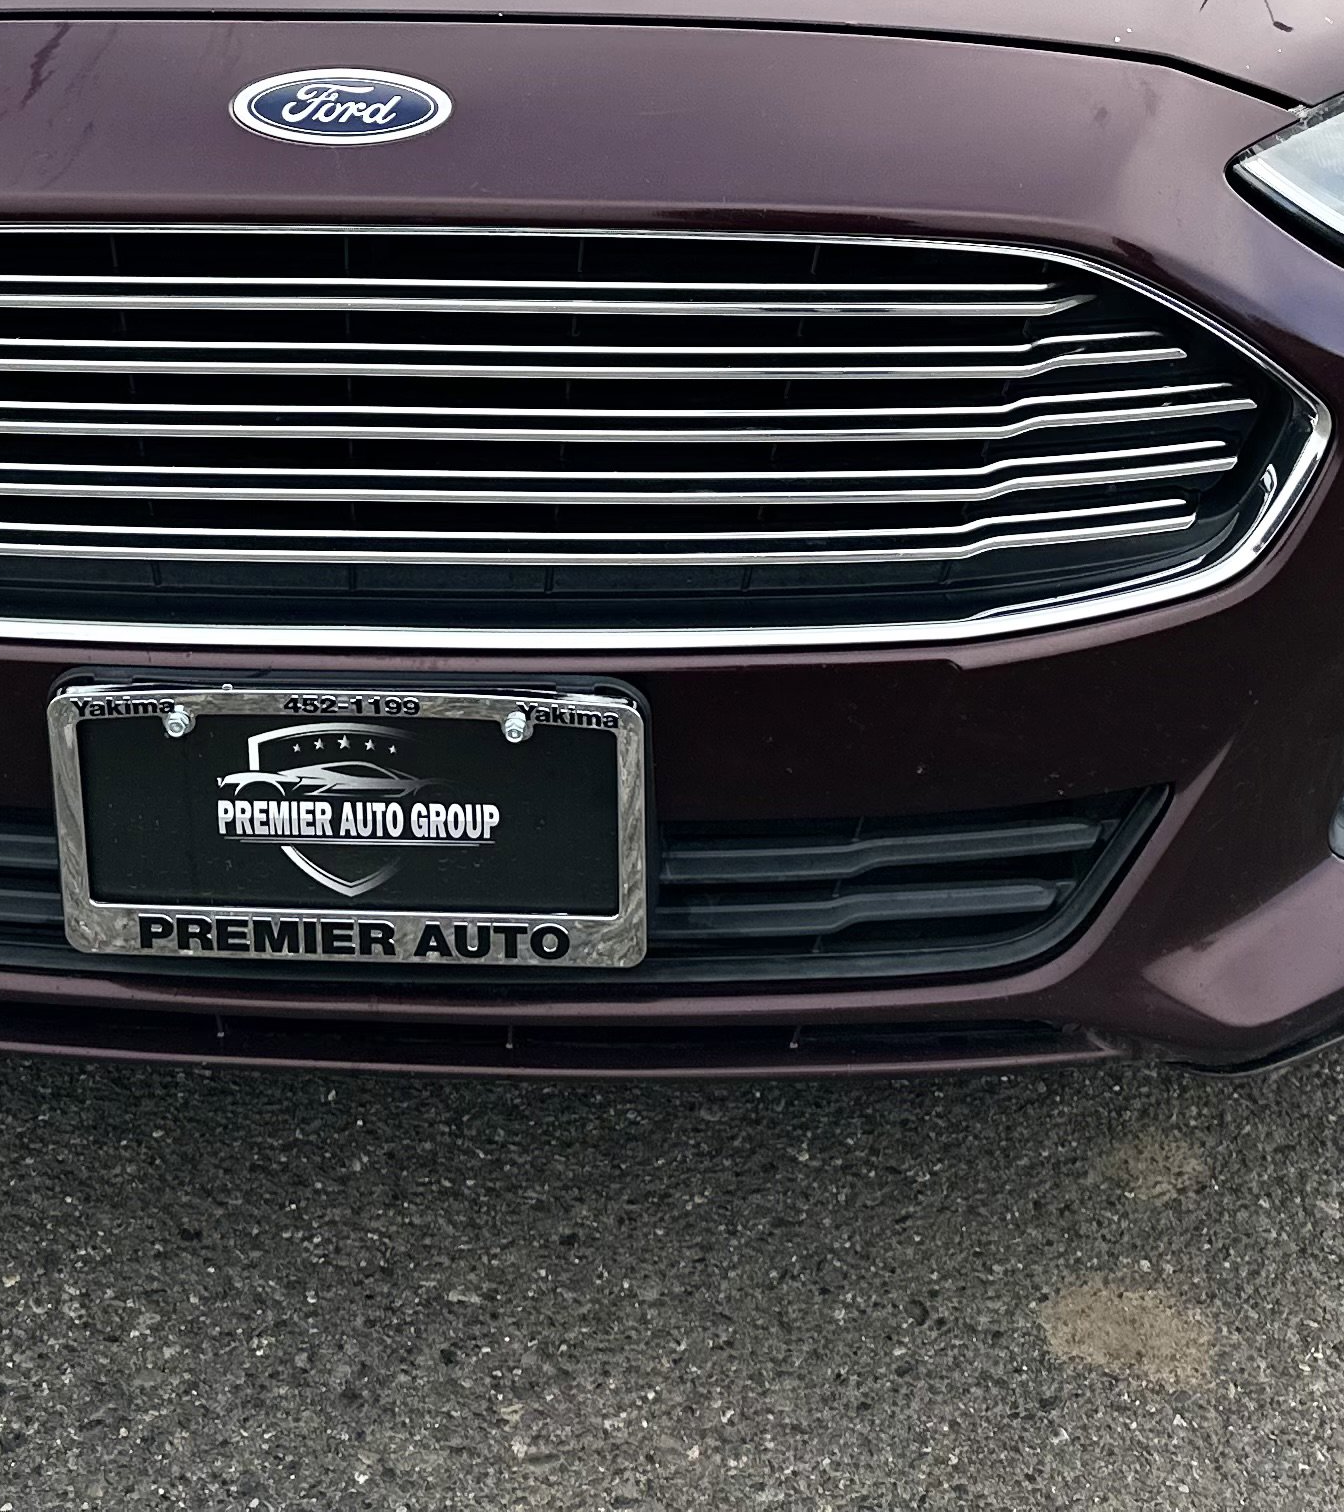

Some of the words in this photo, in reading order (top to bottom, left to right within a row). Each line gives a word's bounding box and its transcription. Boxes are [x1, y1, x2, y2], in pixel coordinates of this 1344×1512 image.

[281, 84, 402, 125] Ford
[69, 696, 176, 717] Yakima
[283, 694, 421, 716] 452-1199
[516, 701, 619, 729] Yakima
[217, 799, 334, 837] PREMIER
[339, 801, 405, 839] AUTO
[410, 803, 500, 841] GROUP
[137, 914, 398, 957] PREMIER
[413, 921, 571, 961] AUTO
